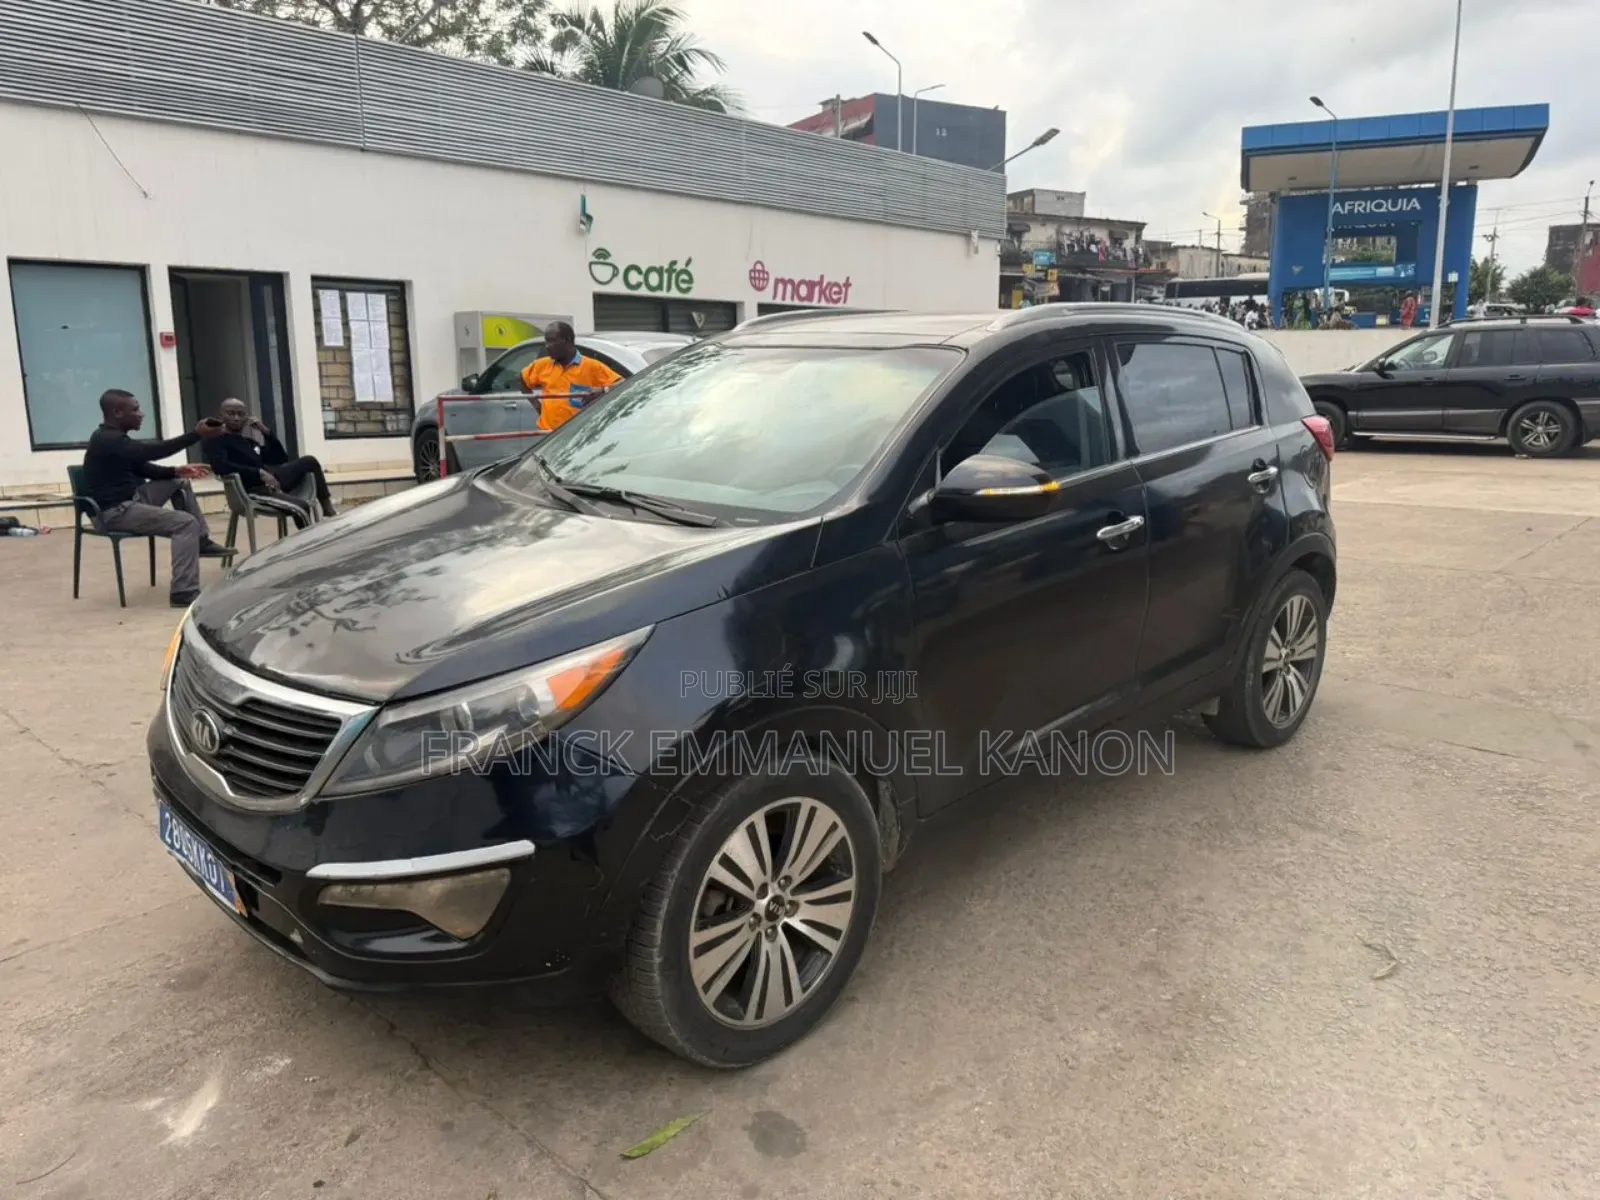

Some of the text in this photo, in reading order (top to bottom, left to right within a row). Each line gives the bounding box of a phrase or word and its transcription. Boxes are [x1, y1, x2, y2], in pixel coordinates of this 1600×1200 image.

[1331, 197, 1421, 215] AFRIQUIA
[622, 257, 694, 294] café
[773, 274, 852, 304] market
